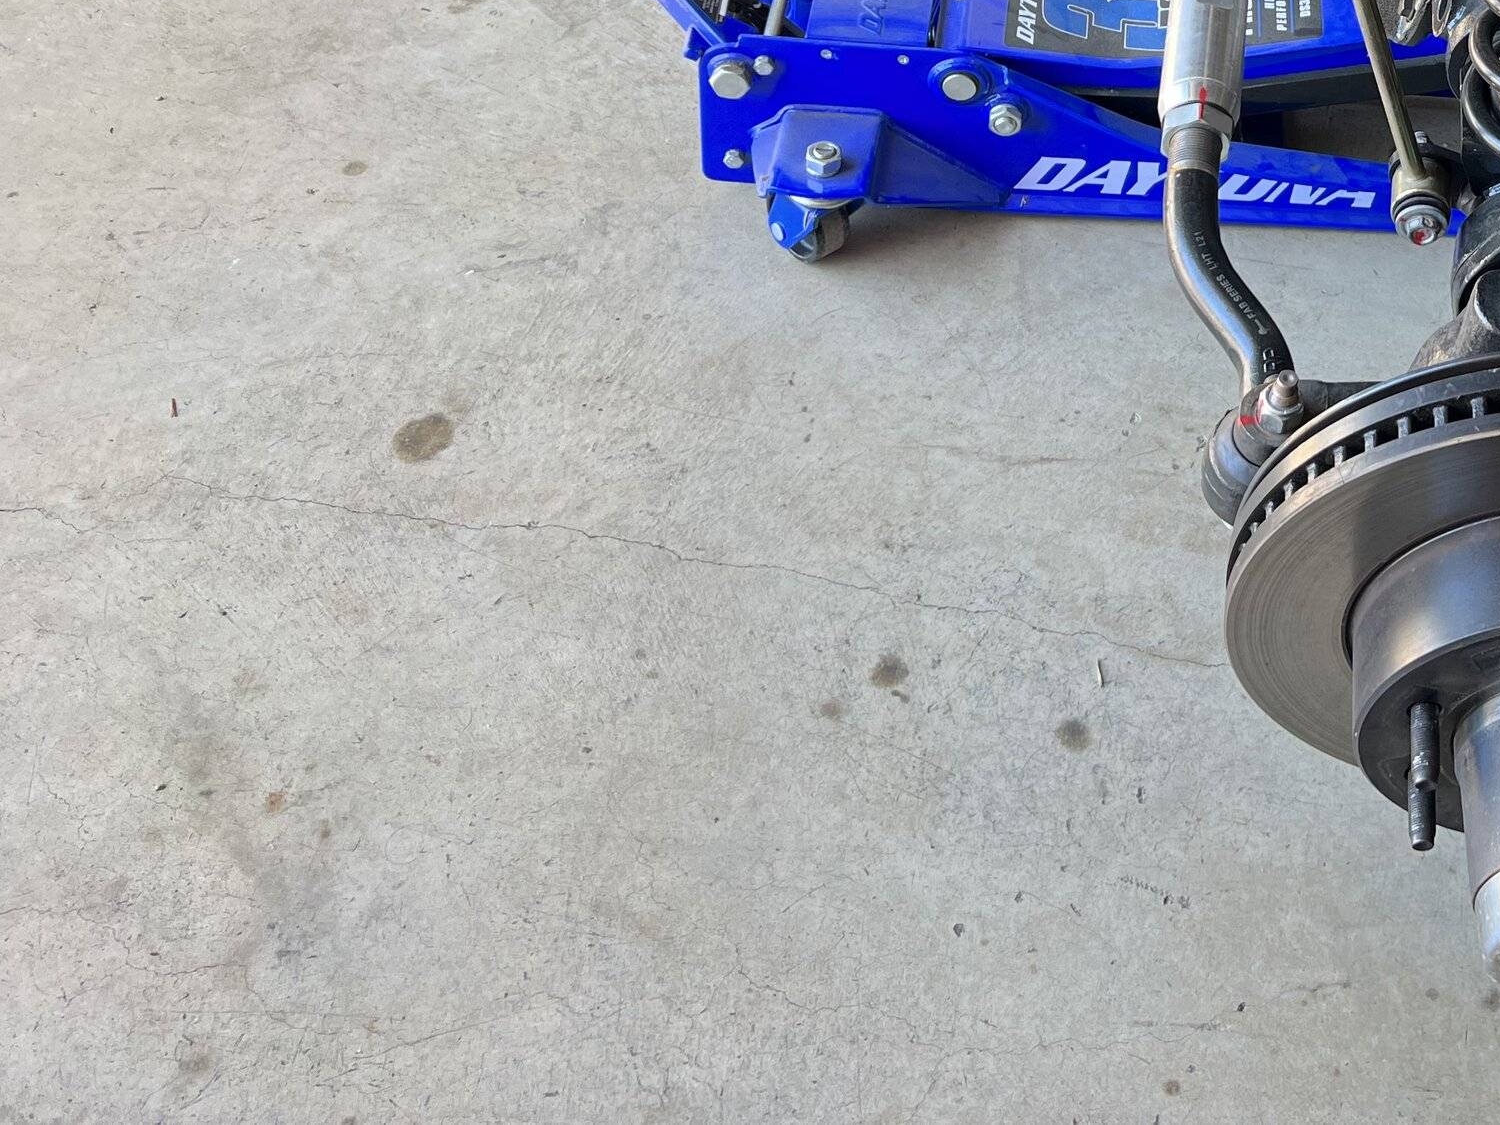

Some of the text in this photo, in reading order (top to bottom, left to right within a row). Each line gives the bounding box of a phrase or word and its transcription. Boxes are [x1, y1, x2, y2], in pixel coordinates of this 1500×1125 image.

[1013, 156, 1376, 209] DAYONA
[1216, 273, 1242, 303] SERIES
[1239, 300, 1256, 320] FAB
